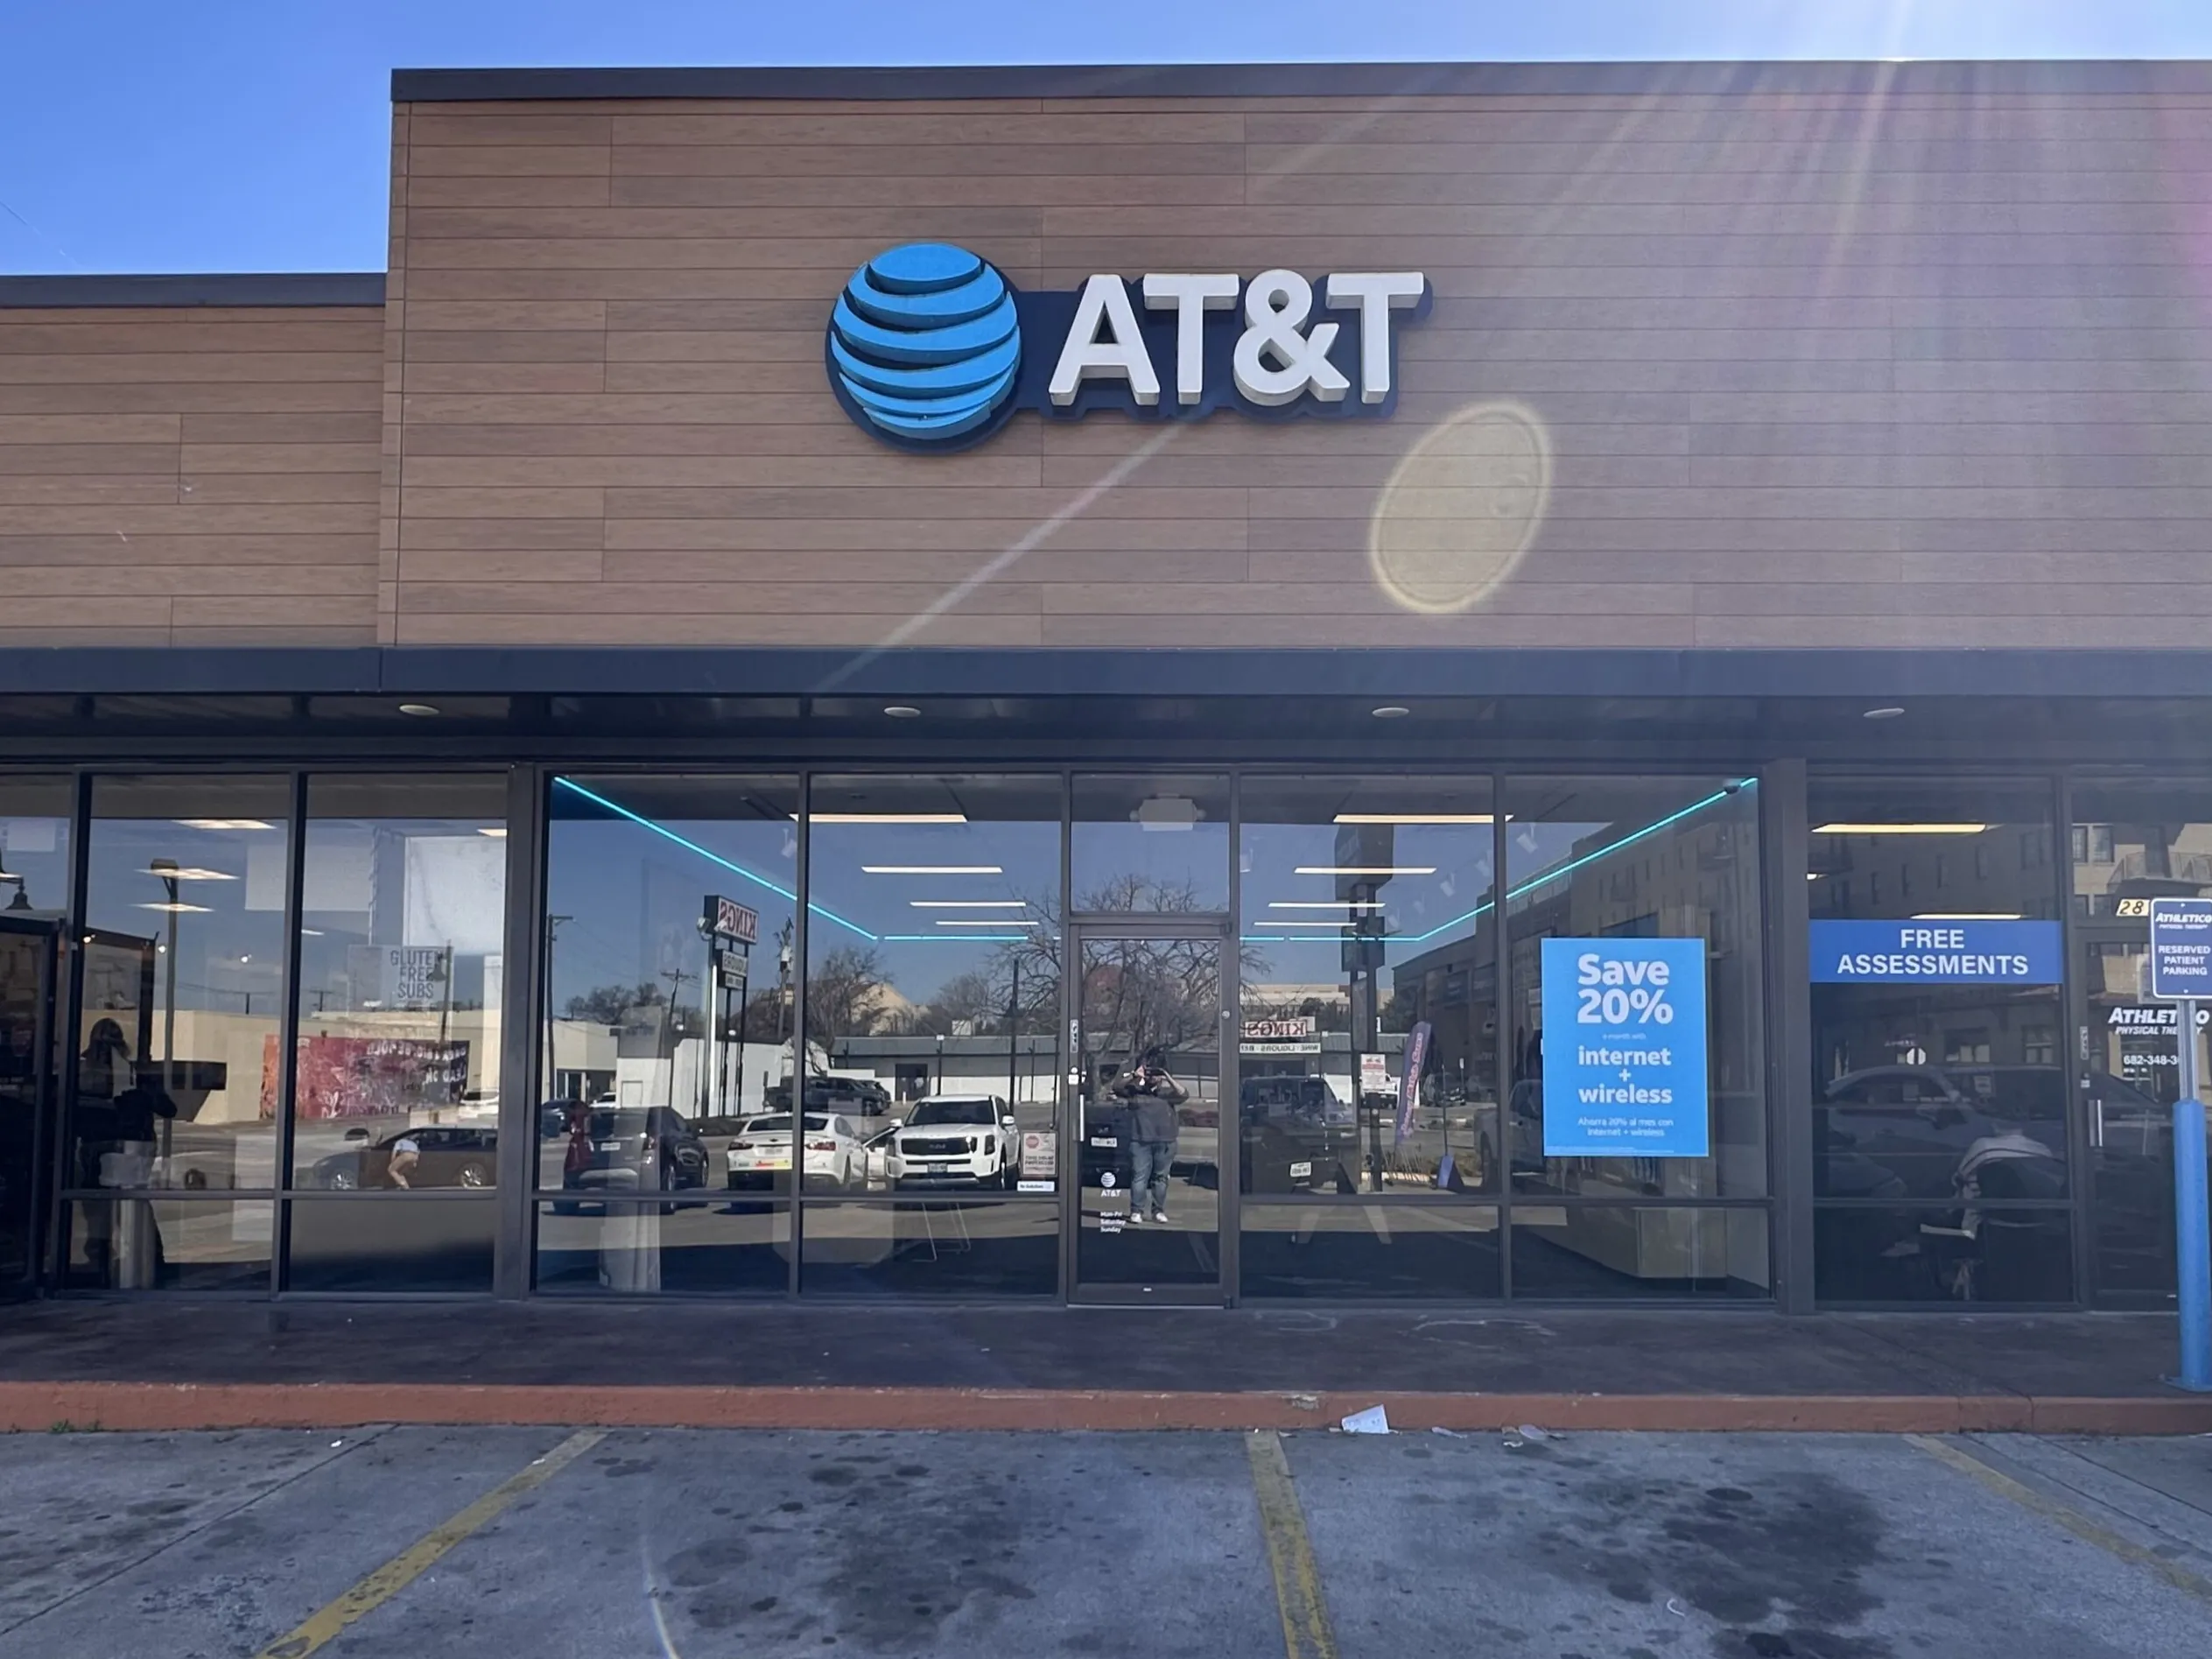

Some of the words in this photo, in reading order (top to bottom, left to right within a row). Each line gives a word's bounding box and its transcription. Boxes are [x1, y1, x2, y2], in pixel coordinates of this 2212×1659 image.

[1049, 268, 1424, 405] AT&T
[2119, 901, 2144, 915] 28
[2155, 912, 2212, 924] ATHLETICO
[1900, 929, 1965, 949] FREE
[2158, 945, 2211, 954] RESERVED
[1837, 954, 2029, 975] ASSESSMENTS
[2164, 956, 2205, 965] PATIENT
[1577, 953, 1670, 986] Save
[2163, 967, 2208, 975] PARKING
[397, 982, 434, 999] SUBS
[1577, 988, 1674, 1024] 20%
[2108, 1007, 2209, 1024] ATHLETO
[2115, 1026, 2159, 1035] PHYSICAL
[2161, 1026, 2202, 1035] THEY
[1578, 1045, 1672, 1066] internet
[2123, 1055, 2179, 1065] 682-348-3
[1619, 1068, 1631, 1082] +
[1578, 1084, 1673, 1104] wireless
[1100, 1189, 1121, 1198] AT&T
